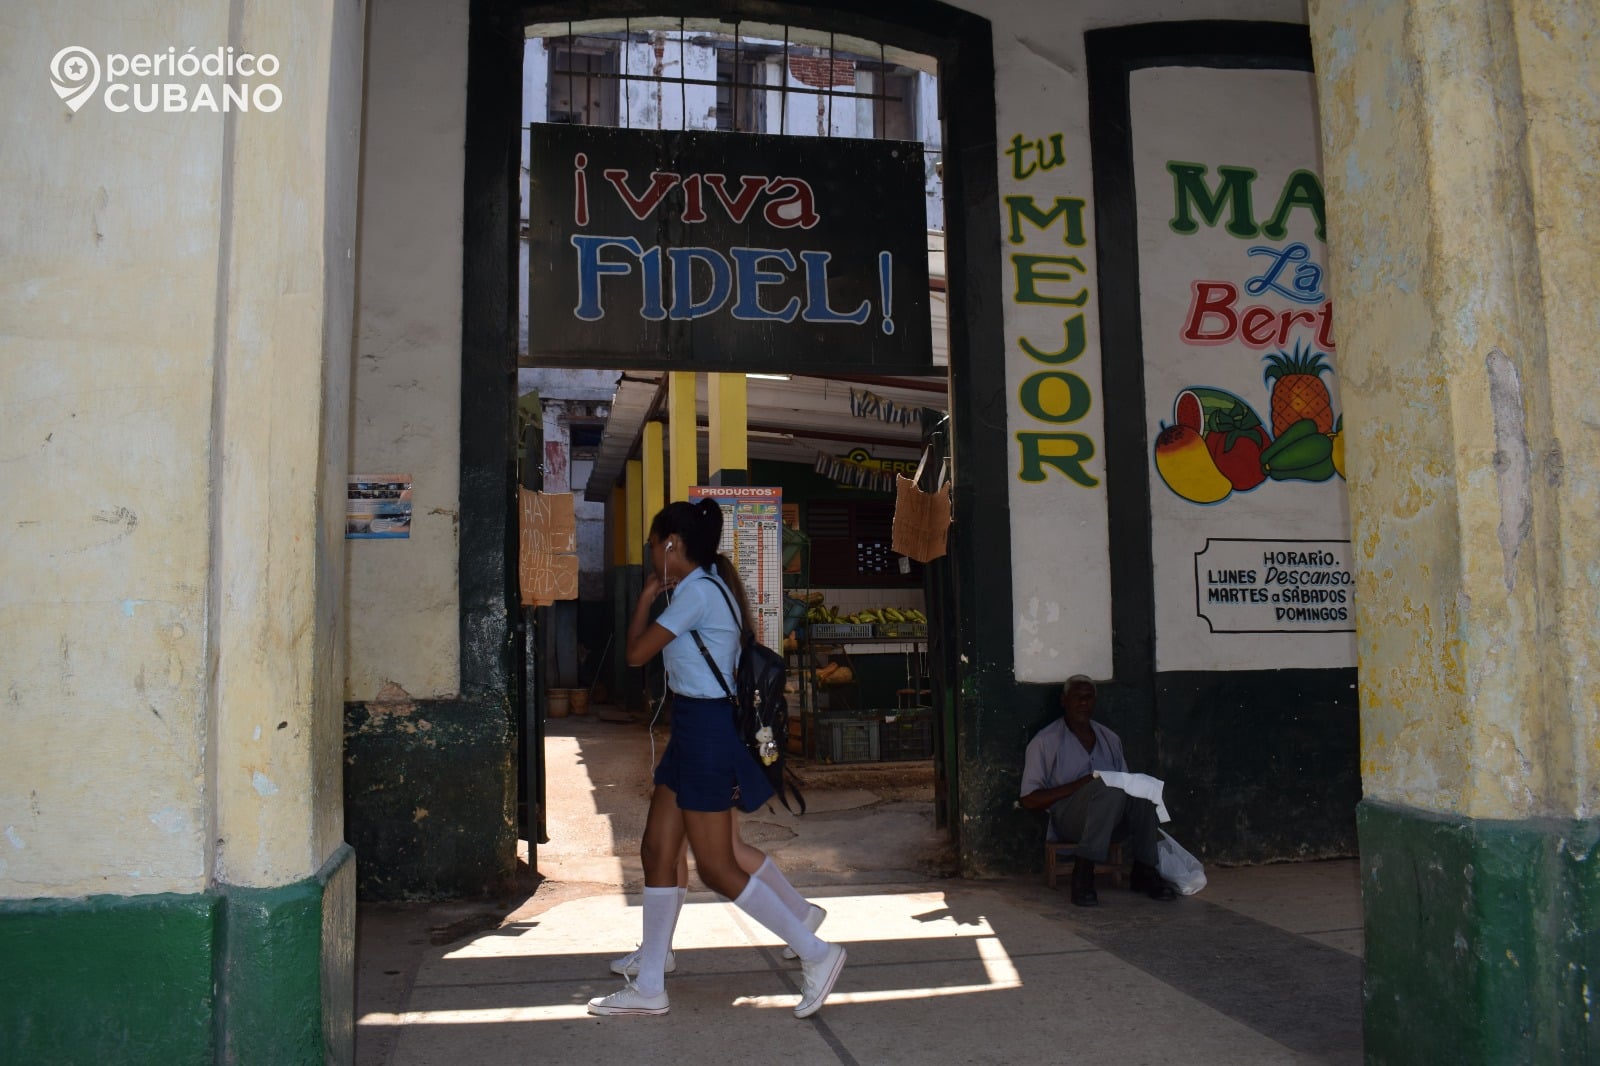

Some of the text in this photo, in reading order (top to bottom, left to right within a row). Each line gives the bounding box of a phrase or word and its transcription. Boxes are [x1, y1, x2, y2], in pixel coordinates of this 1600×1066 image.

[1005, 133, 1065, 180] tu
[1244, 242, 1325, 304] La
[1179, 279, 1336, 352] Bert
[1004, 196, 1099, 489] MEJOR
[701, 488, 772, 496] PRODUCTOS
[523, 495, 551, 528] HAY
[1208, 567, 1355, 585] LUNES Descanso.
[1208, 586, 1347, 604] MARTES a SÁBADOS
[1275, 607, 1348, 621] DOMINGOS
